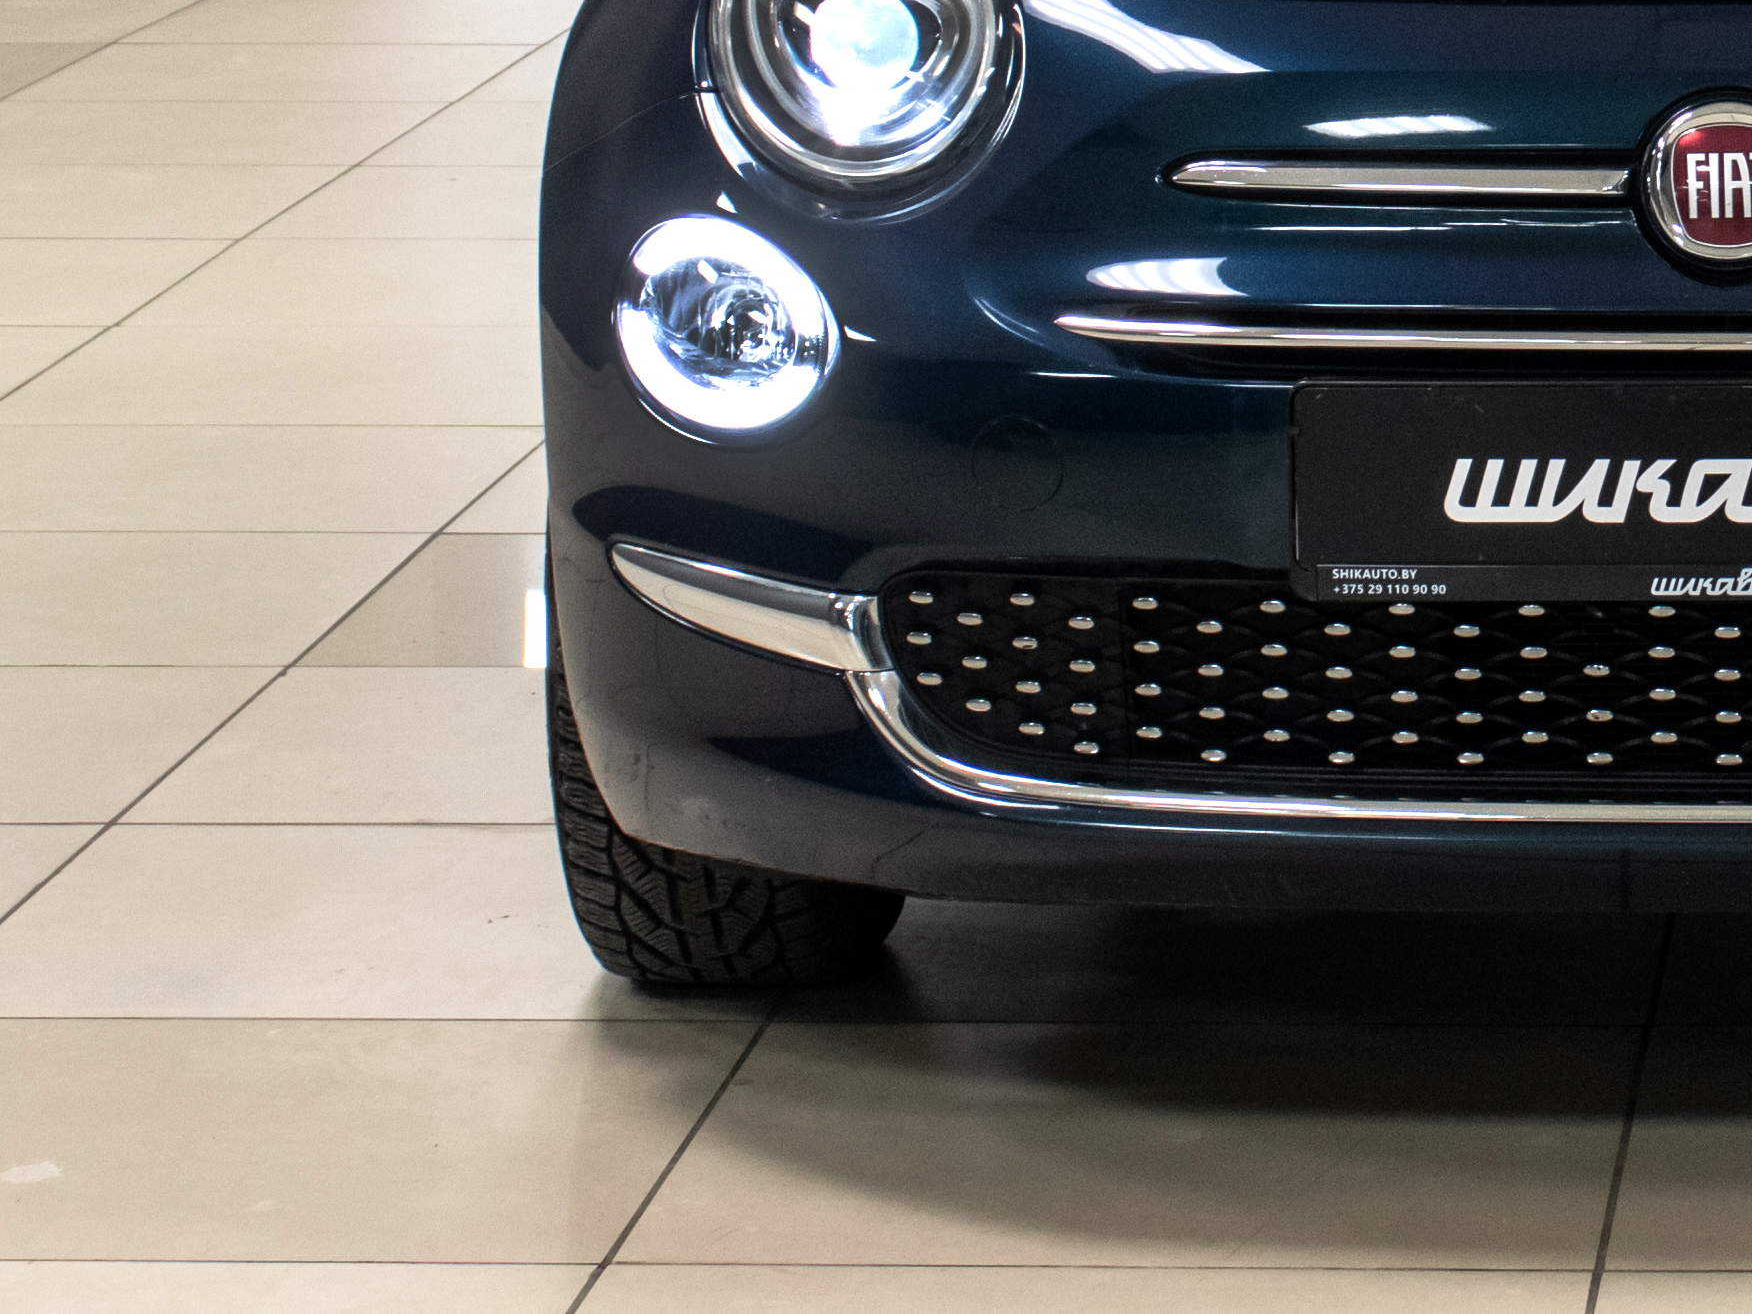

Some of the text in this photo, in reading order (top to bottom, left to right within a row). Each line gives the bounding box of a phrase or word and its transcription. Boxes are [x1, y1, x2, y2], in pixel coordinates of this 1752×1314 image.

[1332, 568, 1418, 580] SHIKAUTO.BY
[1332, 584, 1447, 595] +375 29 110 90 90
